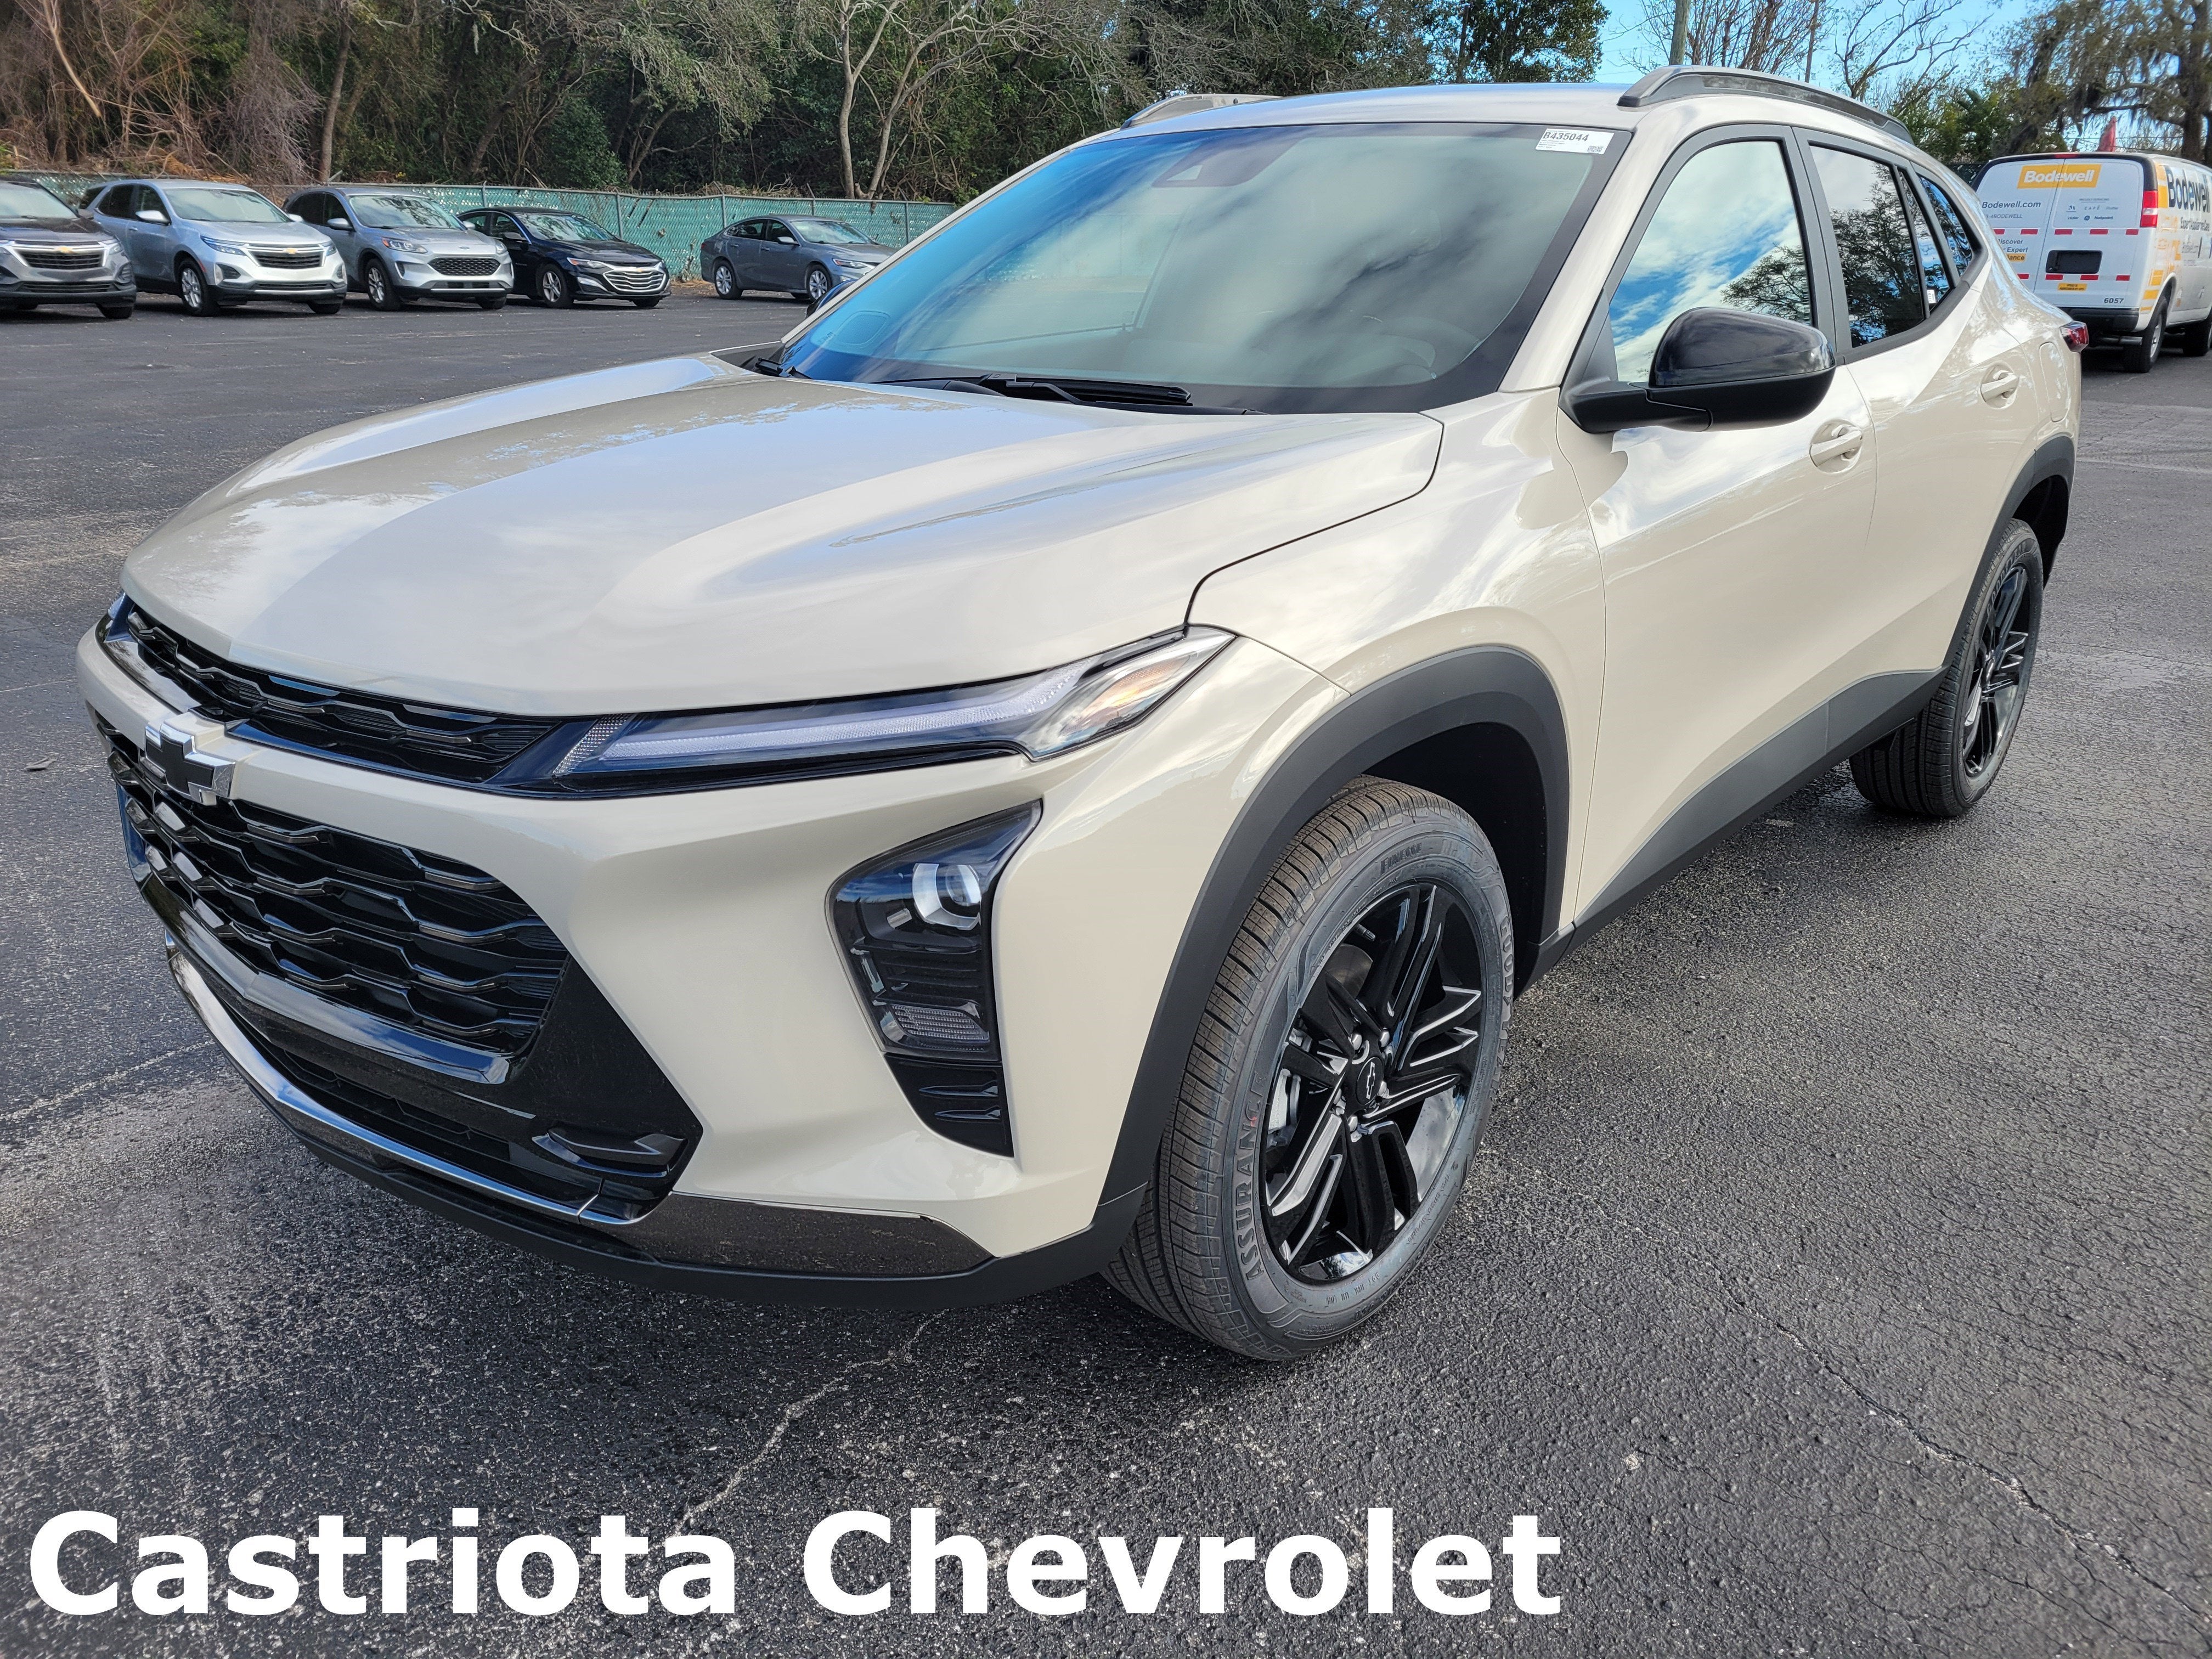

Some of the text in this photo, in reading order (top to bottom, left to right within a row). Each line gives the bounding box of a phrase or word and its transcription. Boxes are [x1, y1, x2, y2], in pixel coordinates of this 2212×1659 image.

[1543, 132, 1589, 142] B435044
[2024, 170, 2095, 183] Bodewell
[1235, 1070, 1266, 1280] ASSURANCE
